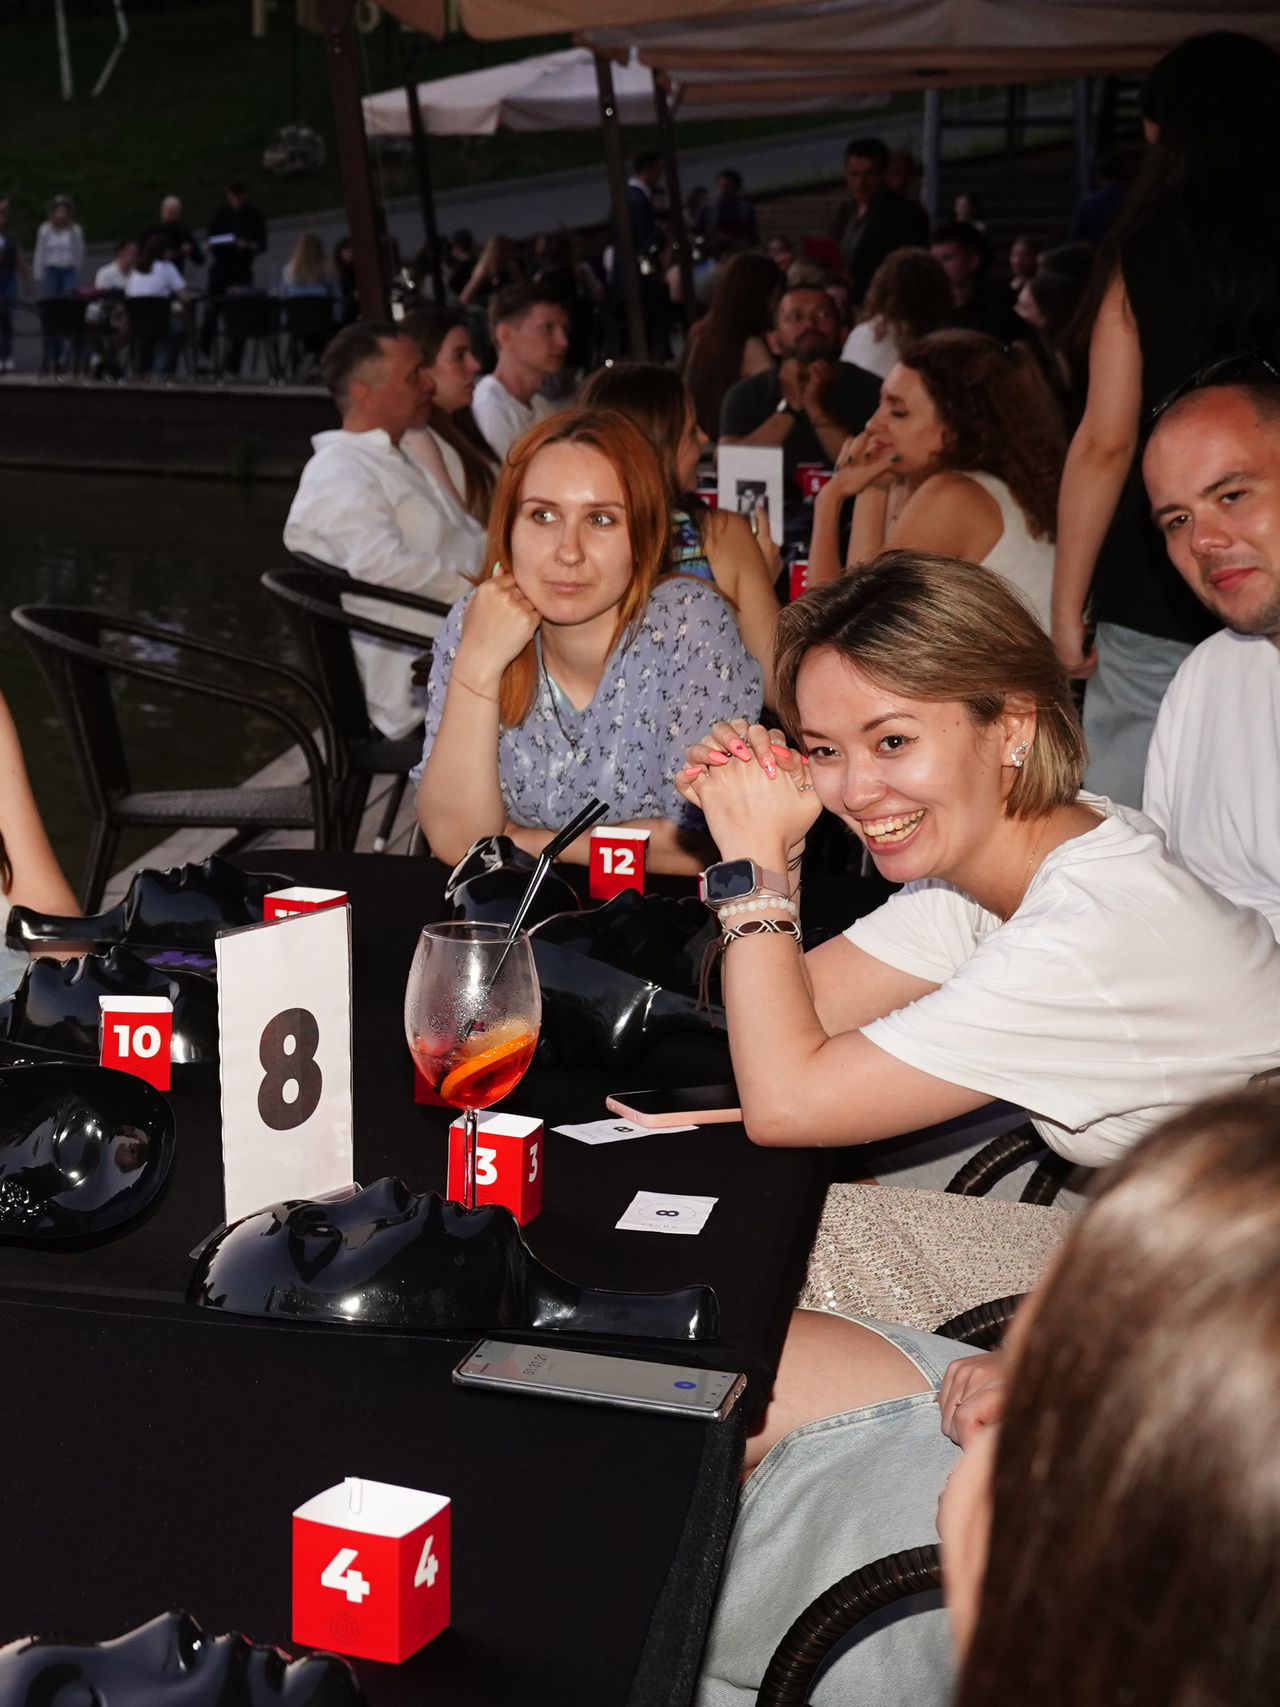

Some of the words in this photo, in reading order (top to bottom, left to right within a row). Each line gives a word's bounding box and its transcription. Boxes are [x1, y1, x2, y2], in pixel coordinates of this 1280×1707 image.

[599, 847, 635, 875] 12
[113, 1025, 161, 1058] 10
[257, 1008, 323, 1131] 8
[475, 1146, 498, 1186] 3
[528, 1142, 538, 1183] 3
[655, 1209, 680, 1217] 8
[320, 1547, 370, 1604] 4
[414, 1534, 439, 1588] 4
